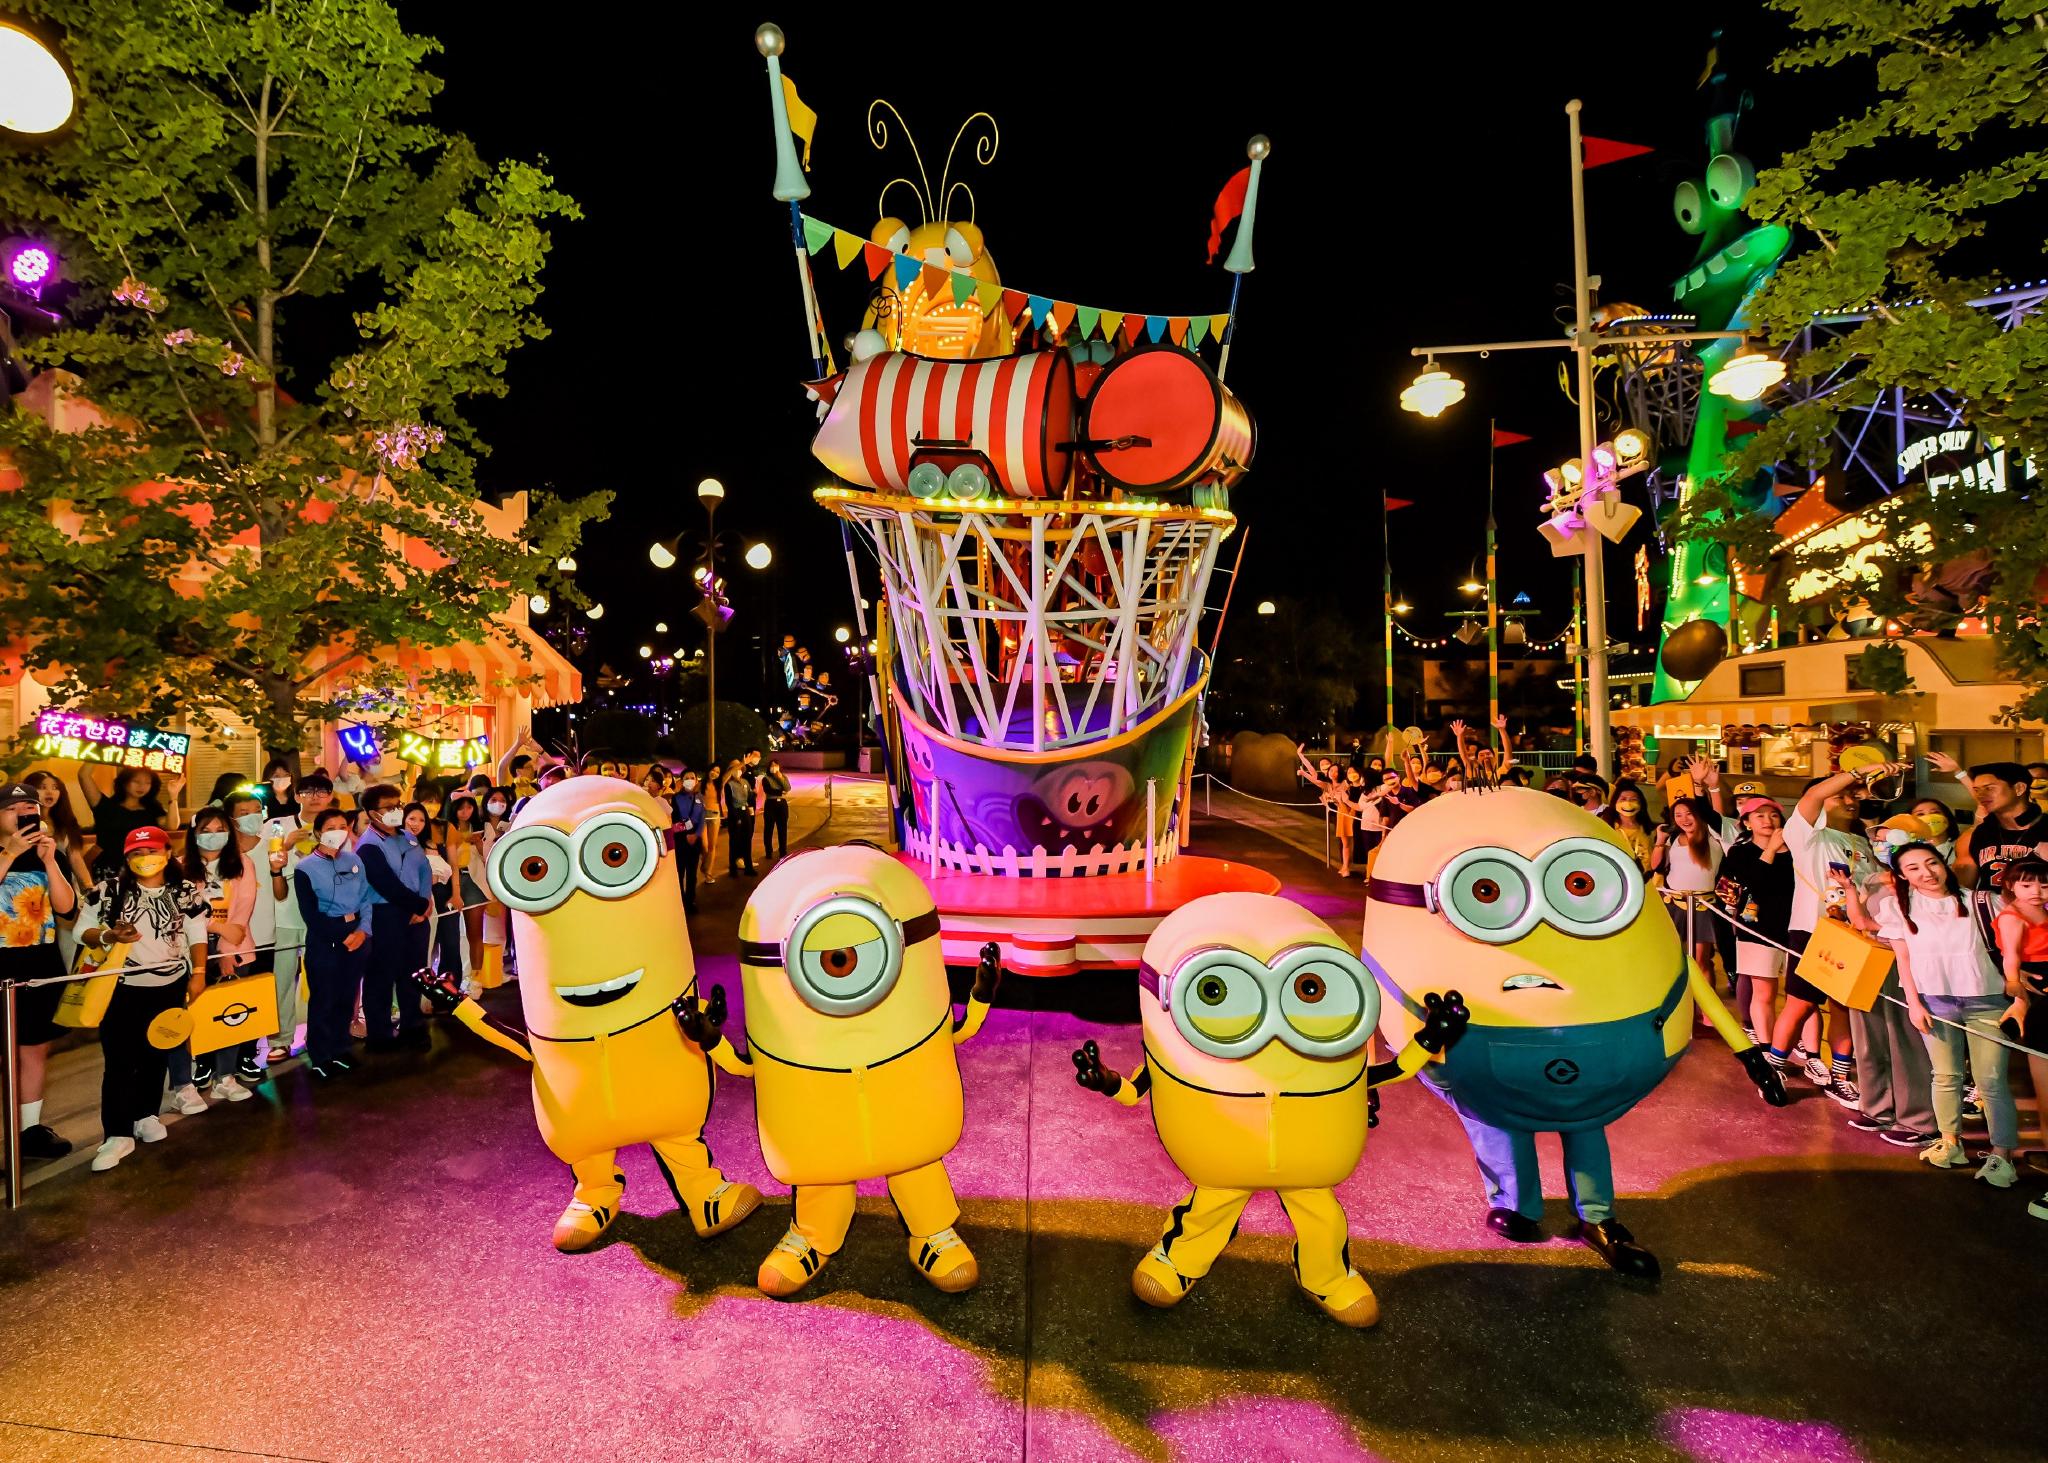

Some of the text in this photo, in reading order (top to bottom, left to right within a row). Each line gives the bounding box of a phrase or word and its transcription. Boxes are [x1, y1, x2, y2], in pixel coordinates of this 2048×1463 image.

[1897, 430, 1974, 475] SUPER SILLY
[39, 713, 188, 755] 花花世界迷人眼
